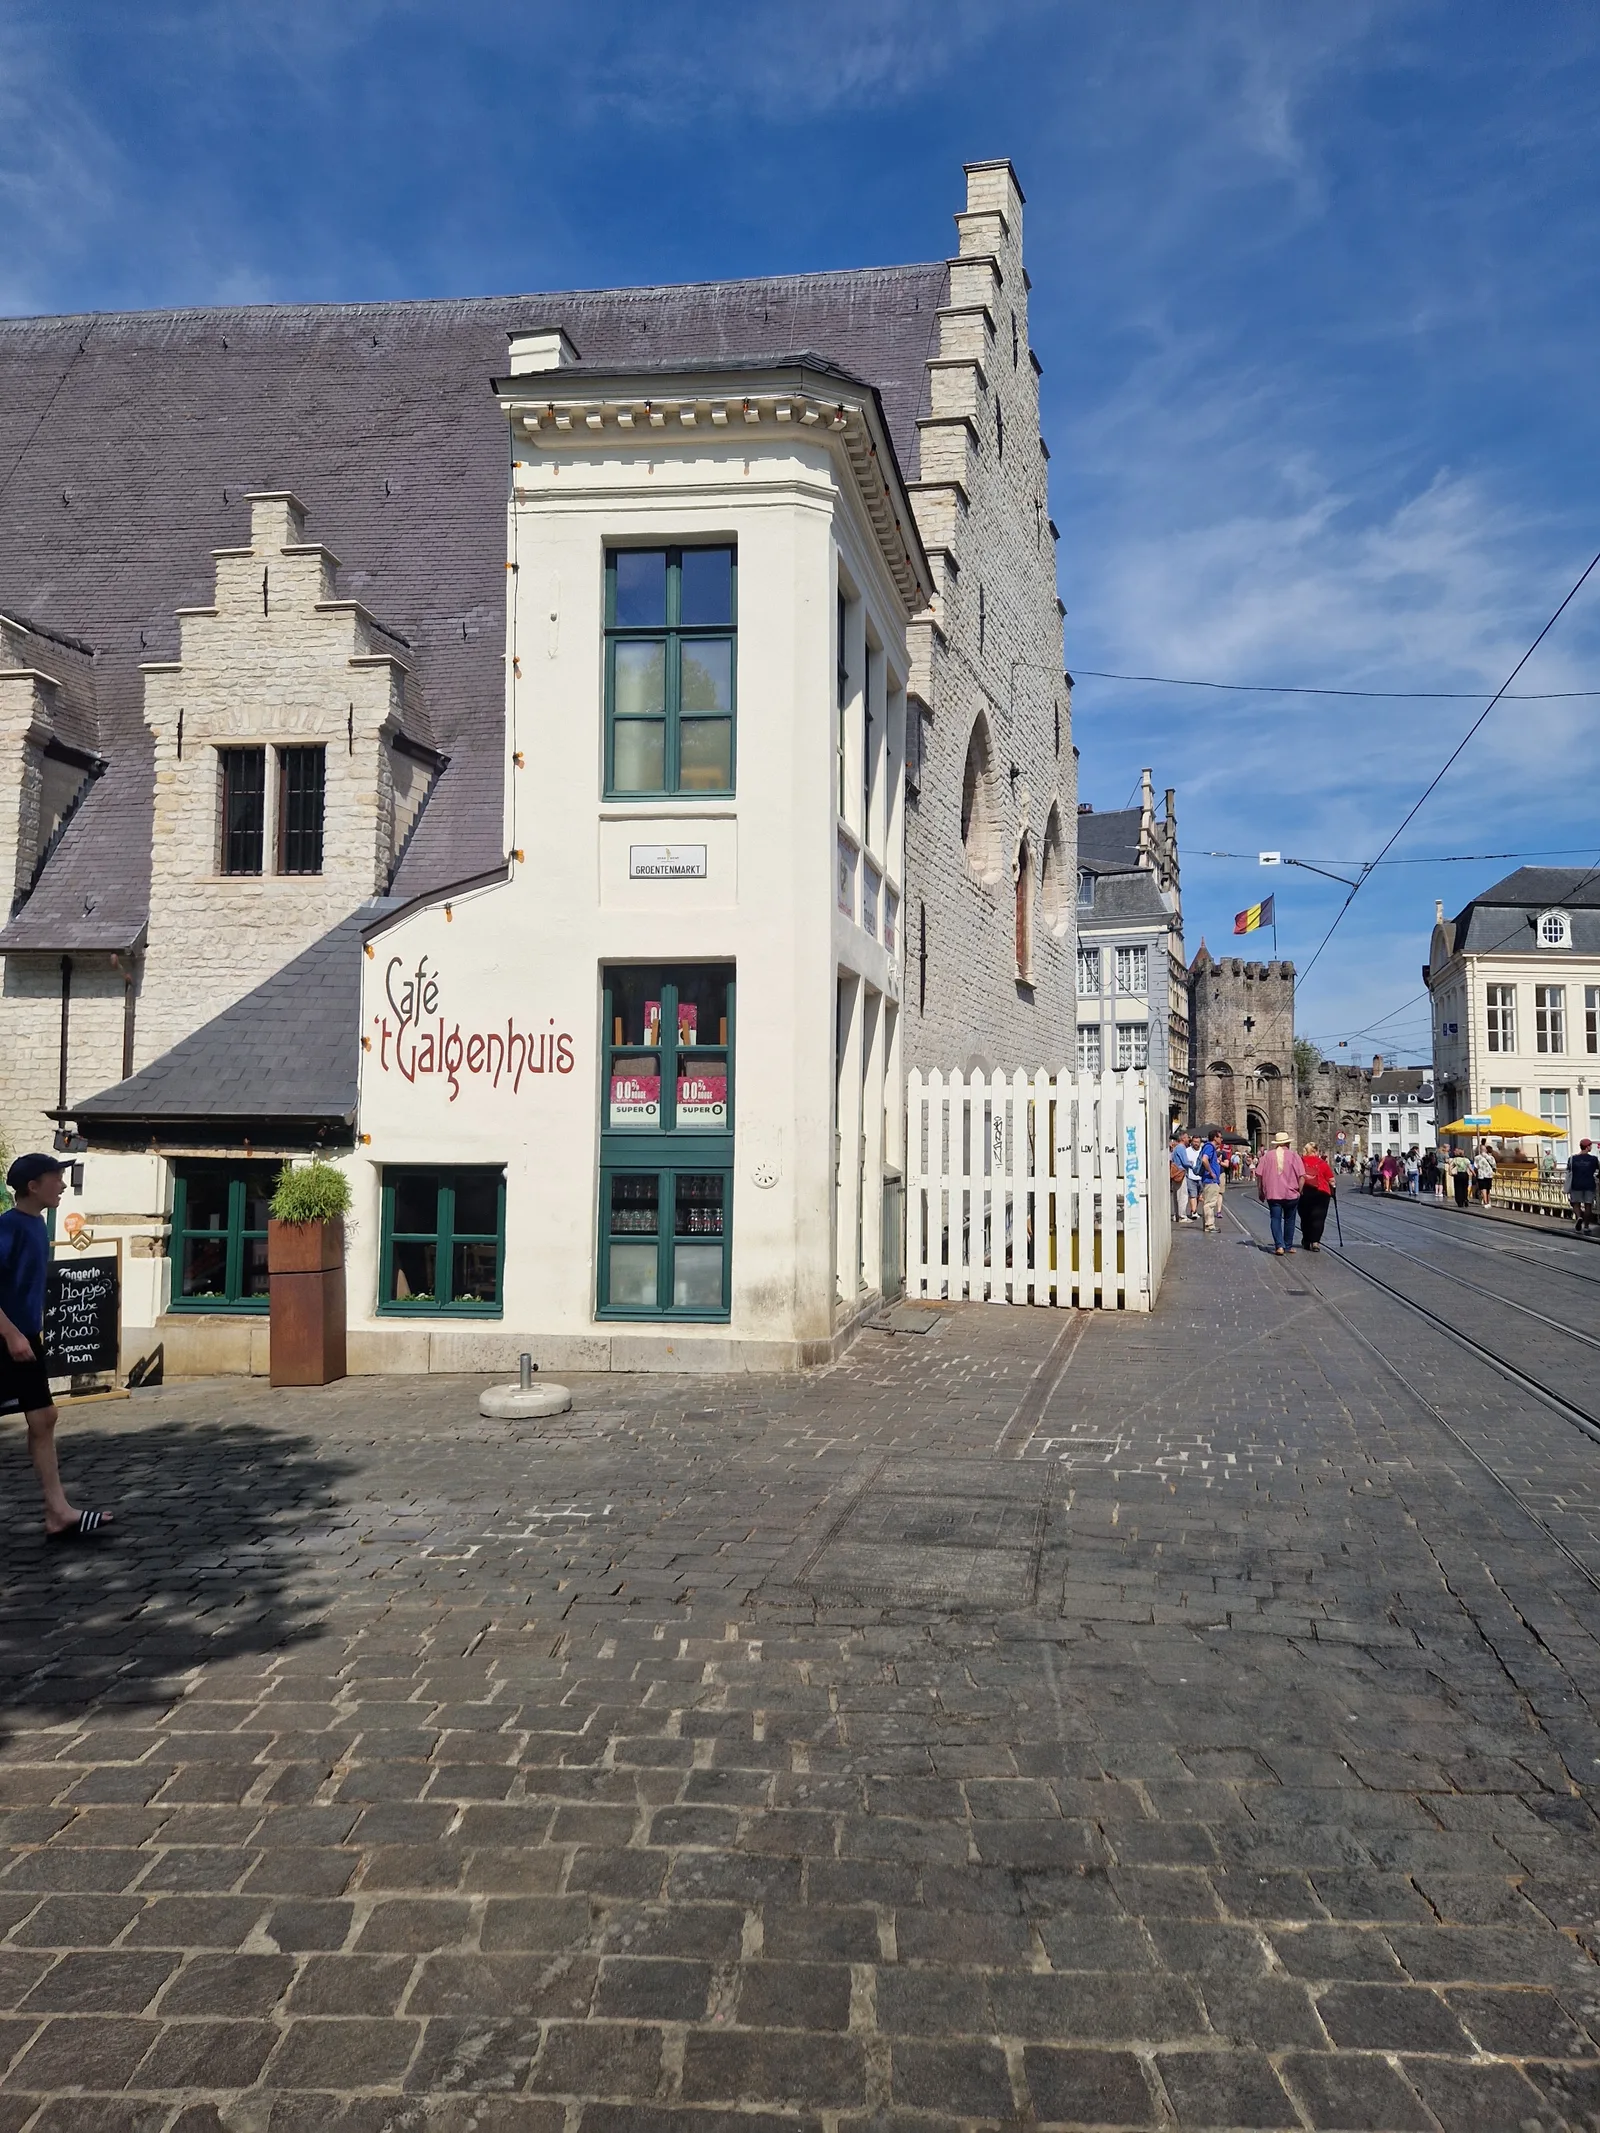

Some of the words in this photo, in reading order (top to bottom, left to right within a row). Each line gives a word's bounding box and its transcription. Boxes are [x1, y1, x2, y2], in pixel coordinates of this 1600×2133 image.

[635, 865, 701, 875] GROENTENMARKT
[385, 954, 439, 1028] Café
[396, 1014, 575, 1102] Galgenhuis
